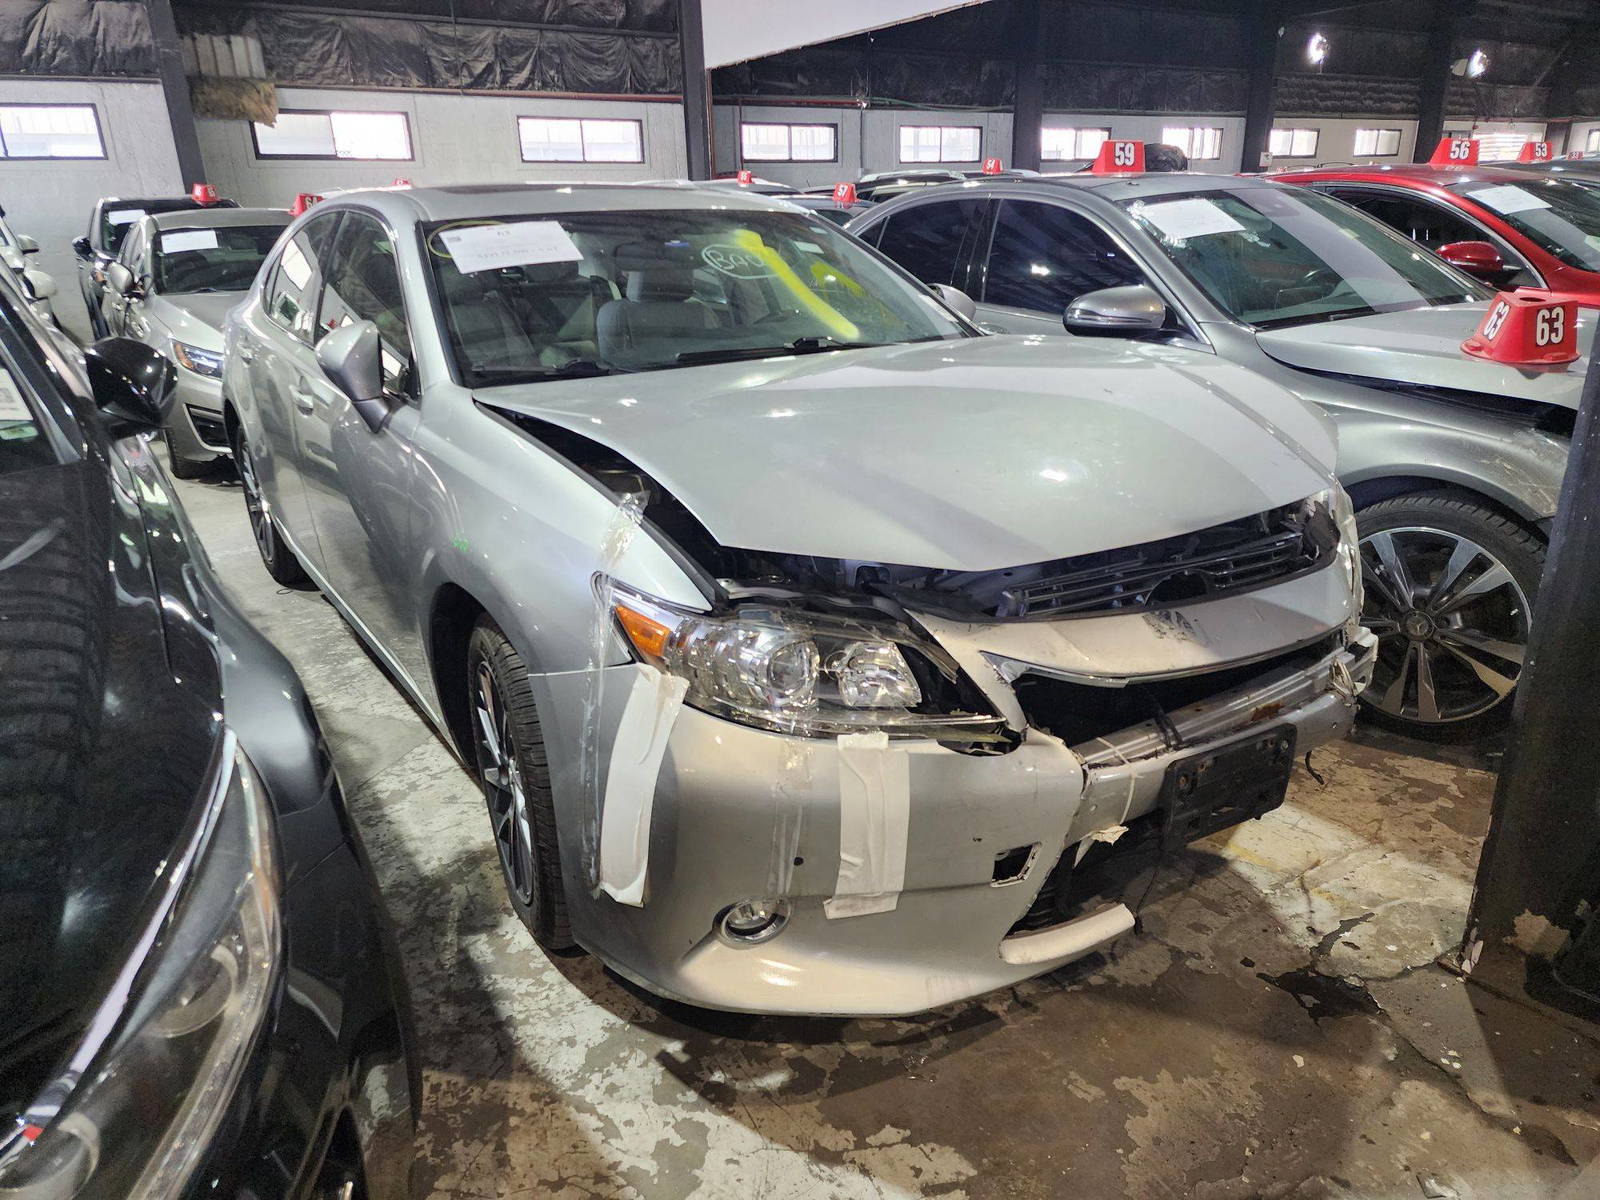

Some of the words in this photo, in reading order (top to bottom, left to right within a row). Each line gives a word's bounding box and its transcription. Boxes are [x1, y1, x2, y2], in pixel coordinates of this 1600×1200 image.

[1114, 142, 1135, 166] 59
[1450, 140, 1470, 159] 56
[1535, 142, 1548, 157] 53
[1483, 301, 1510, 340] 63
[1536, 306, 1564, 346] 63
